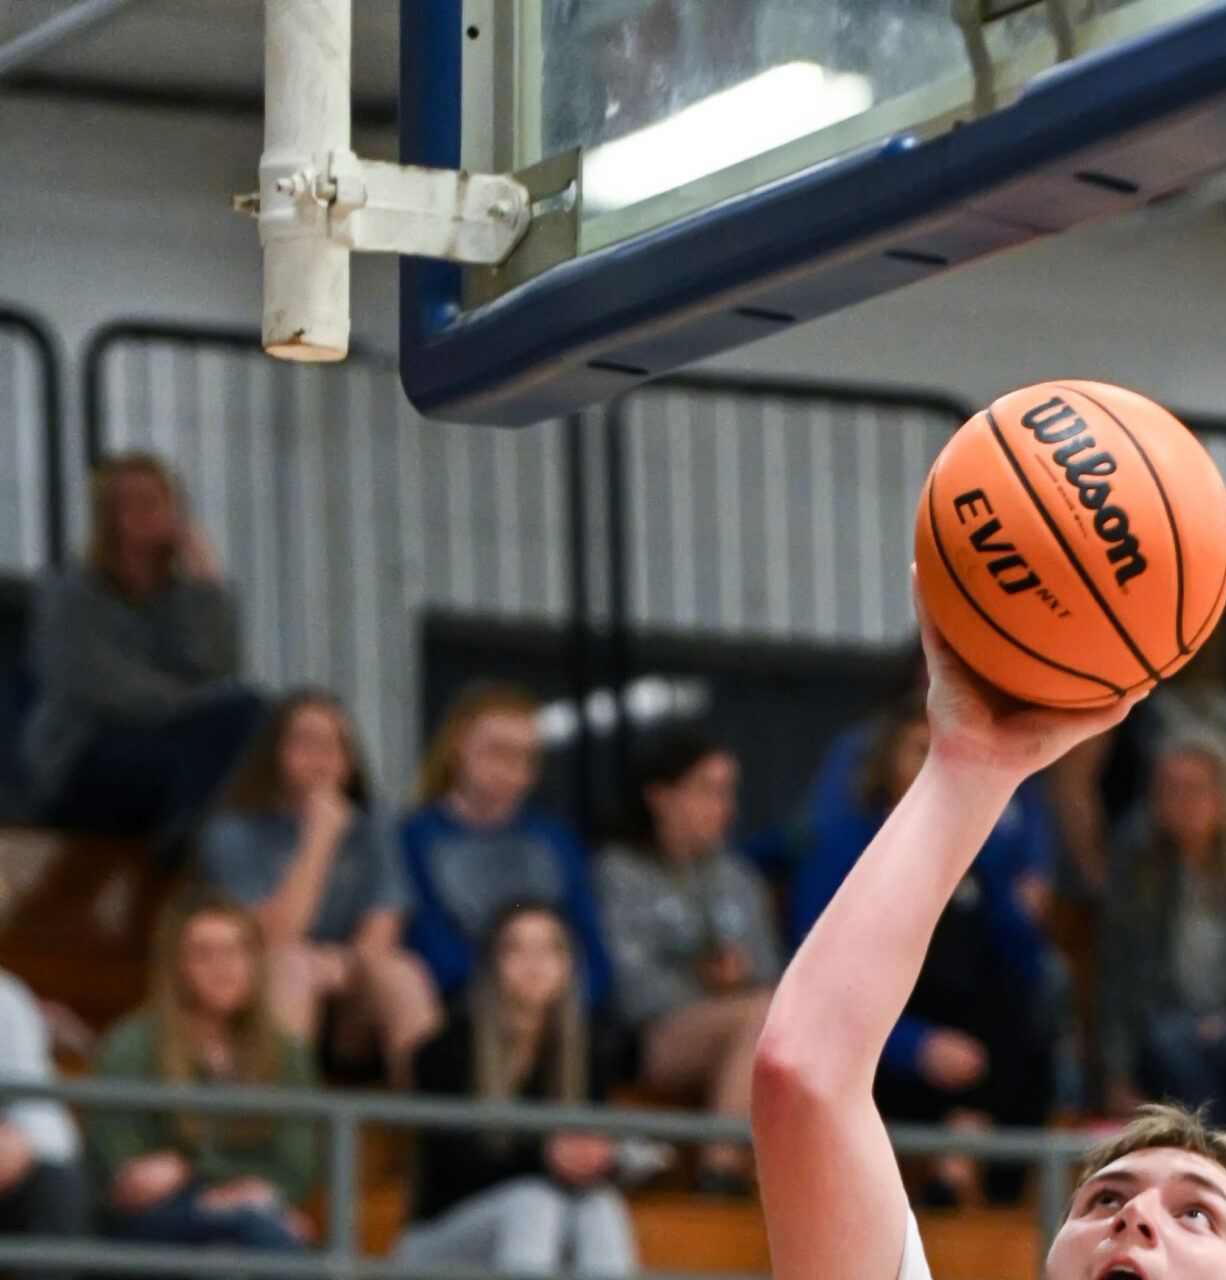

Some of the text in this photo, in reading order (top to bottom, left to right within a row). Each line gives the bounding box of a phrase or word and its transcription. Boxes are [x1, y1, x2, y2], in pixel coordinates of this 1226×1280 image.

[953, 488, 1041, 595] EVO
[1035, 587, 1071, 619] NXT
[1021, 396, 1147, 588] Wilson
